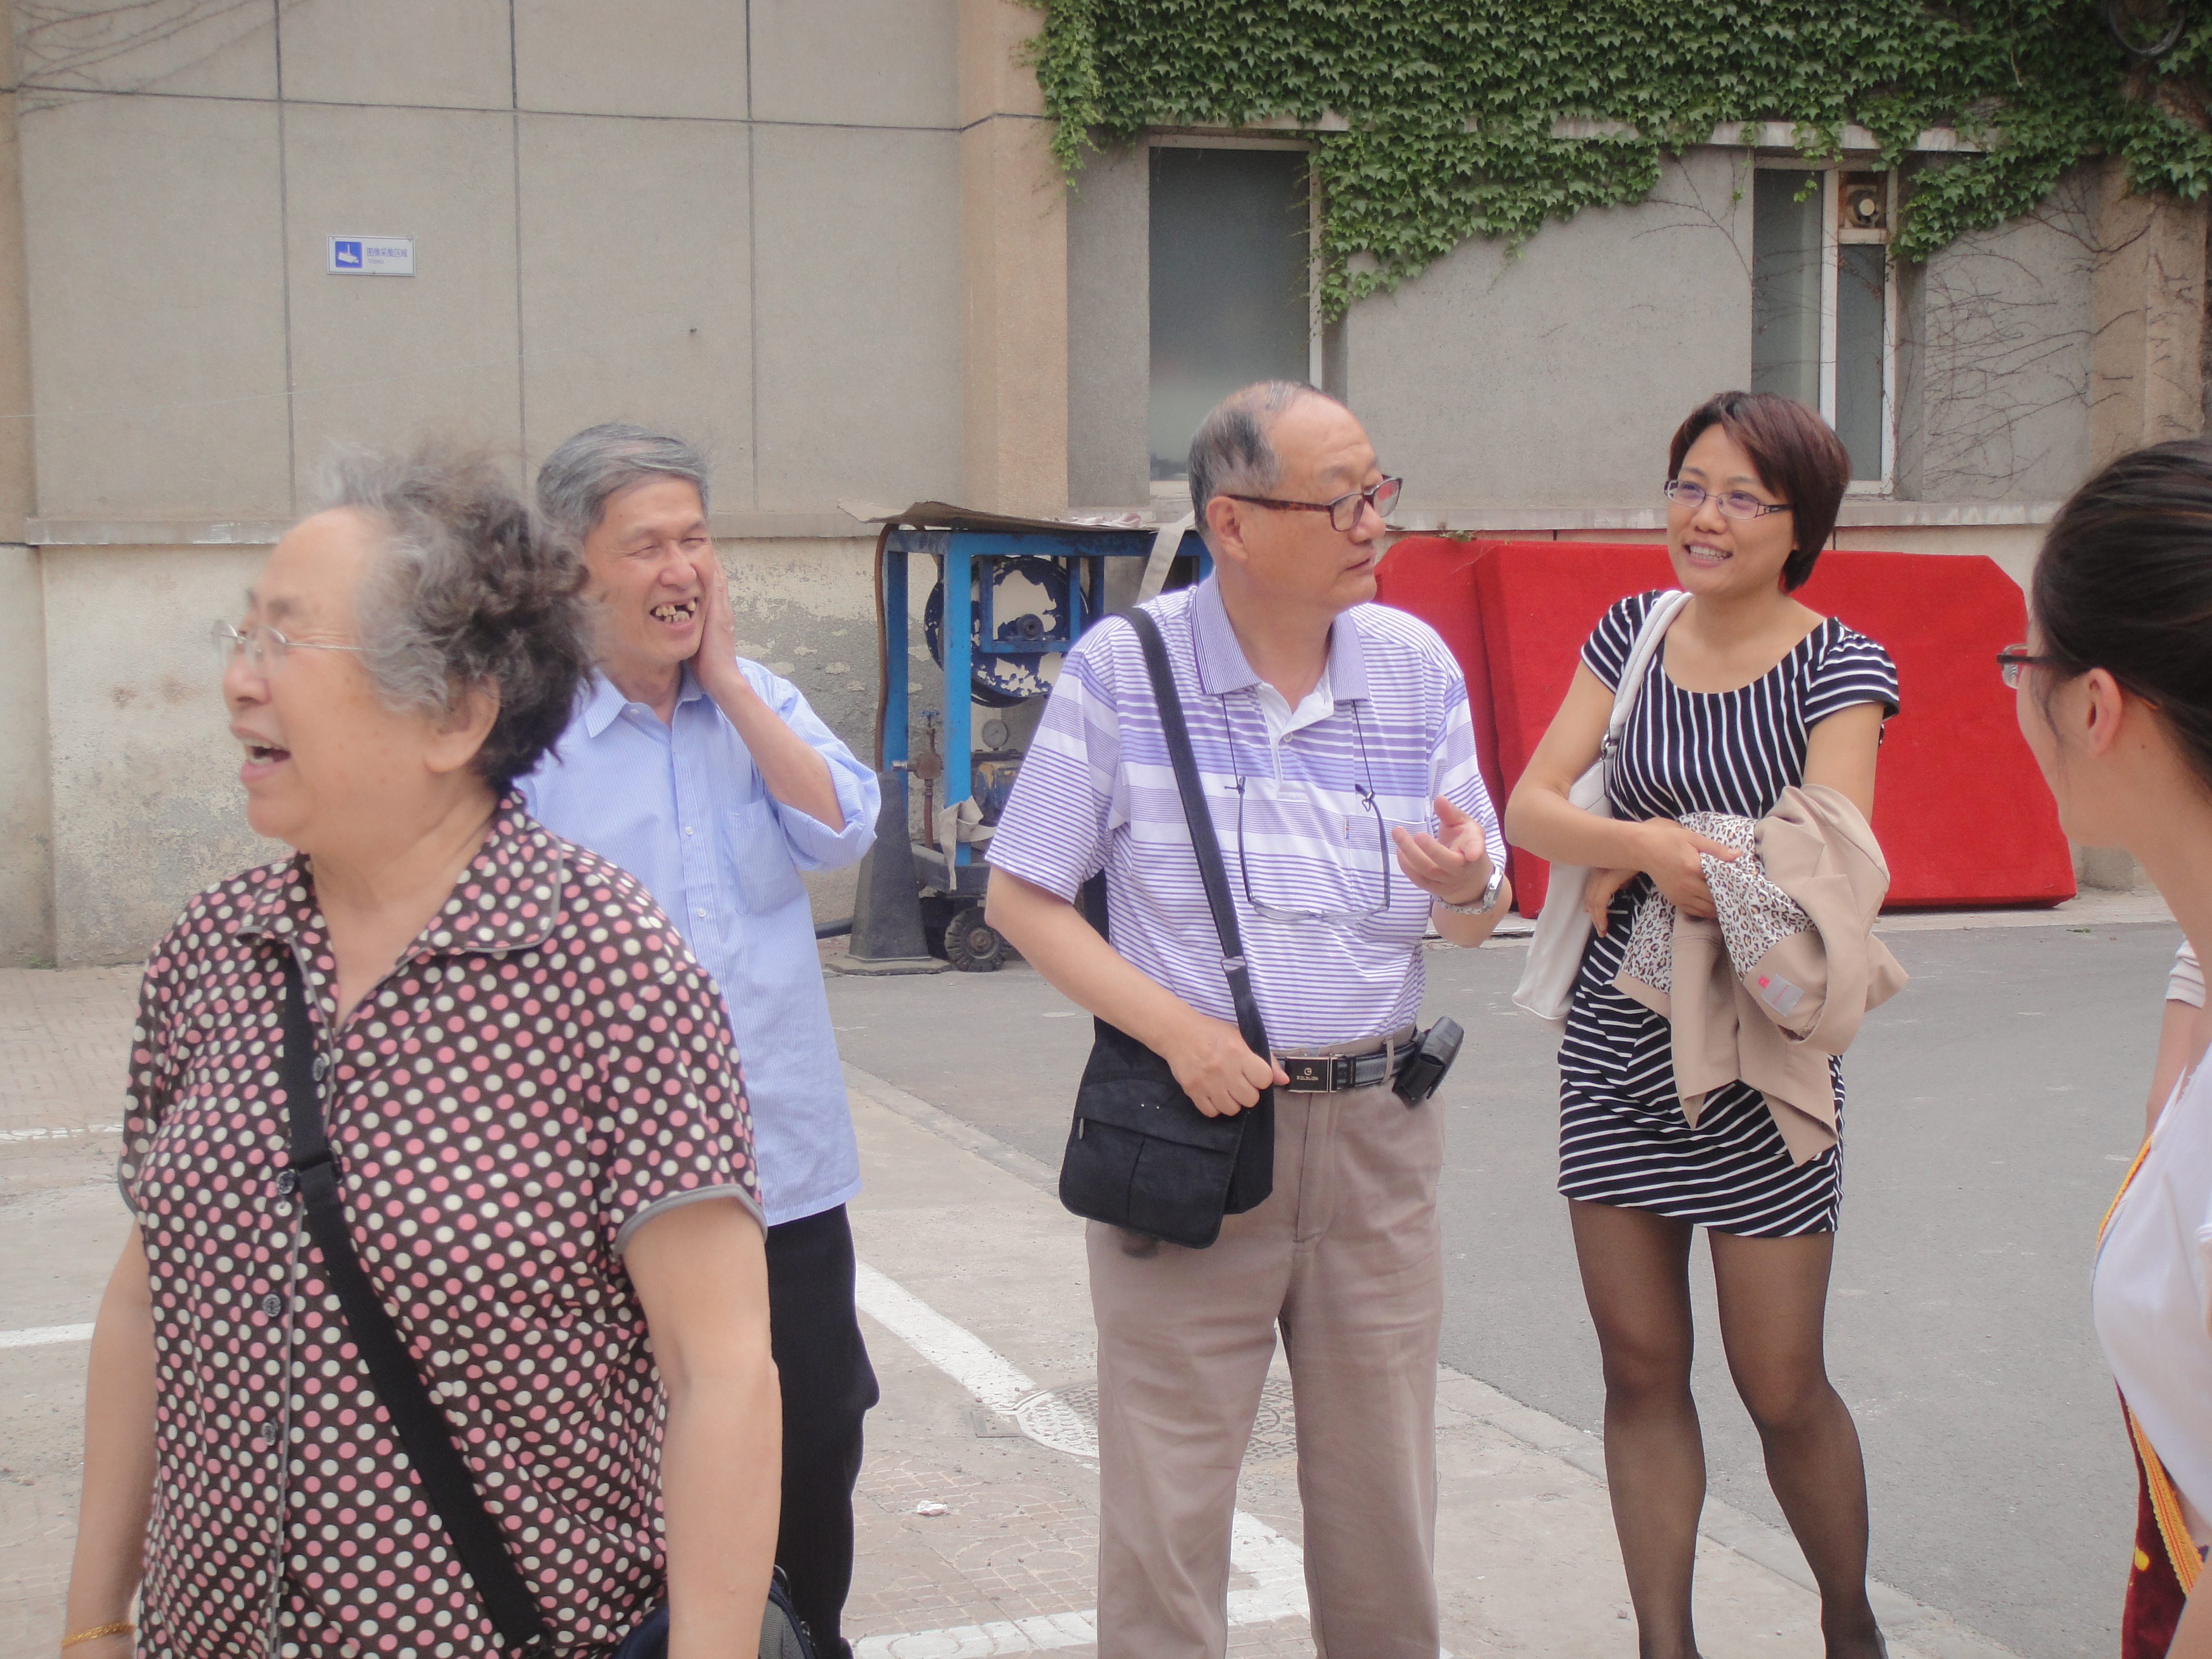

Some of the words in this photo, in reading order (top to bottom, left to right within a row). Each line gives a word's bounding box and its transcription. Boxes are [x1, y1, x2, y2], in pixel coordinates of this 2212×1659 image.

[367, 248, 408, 257] 图像采集区域
